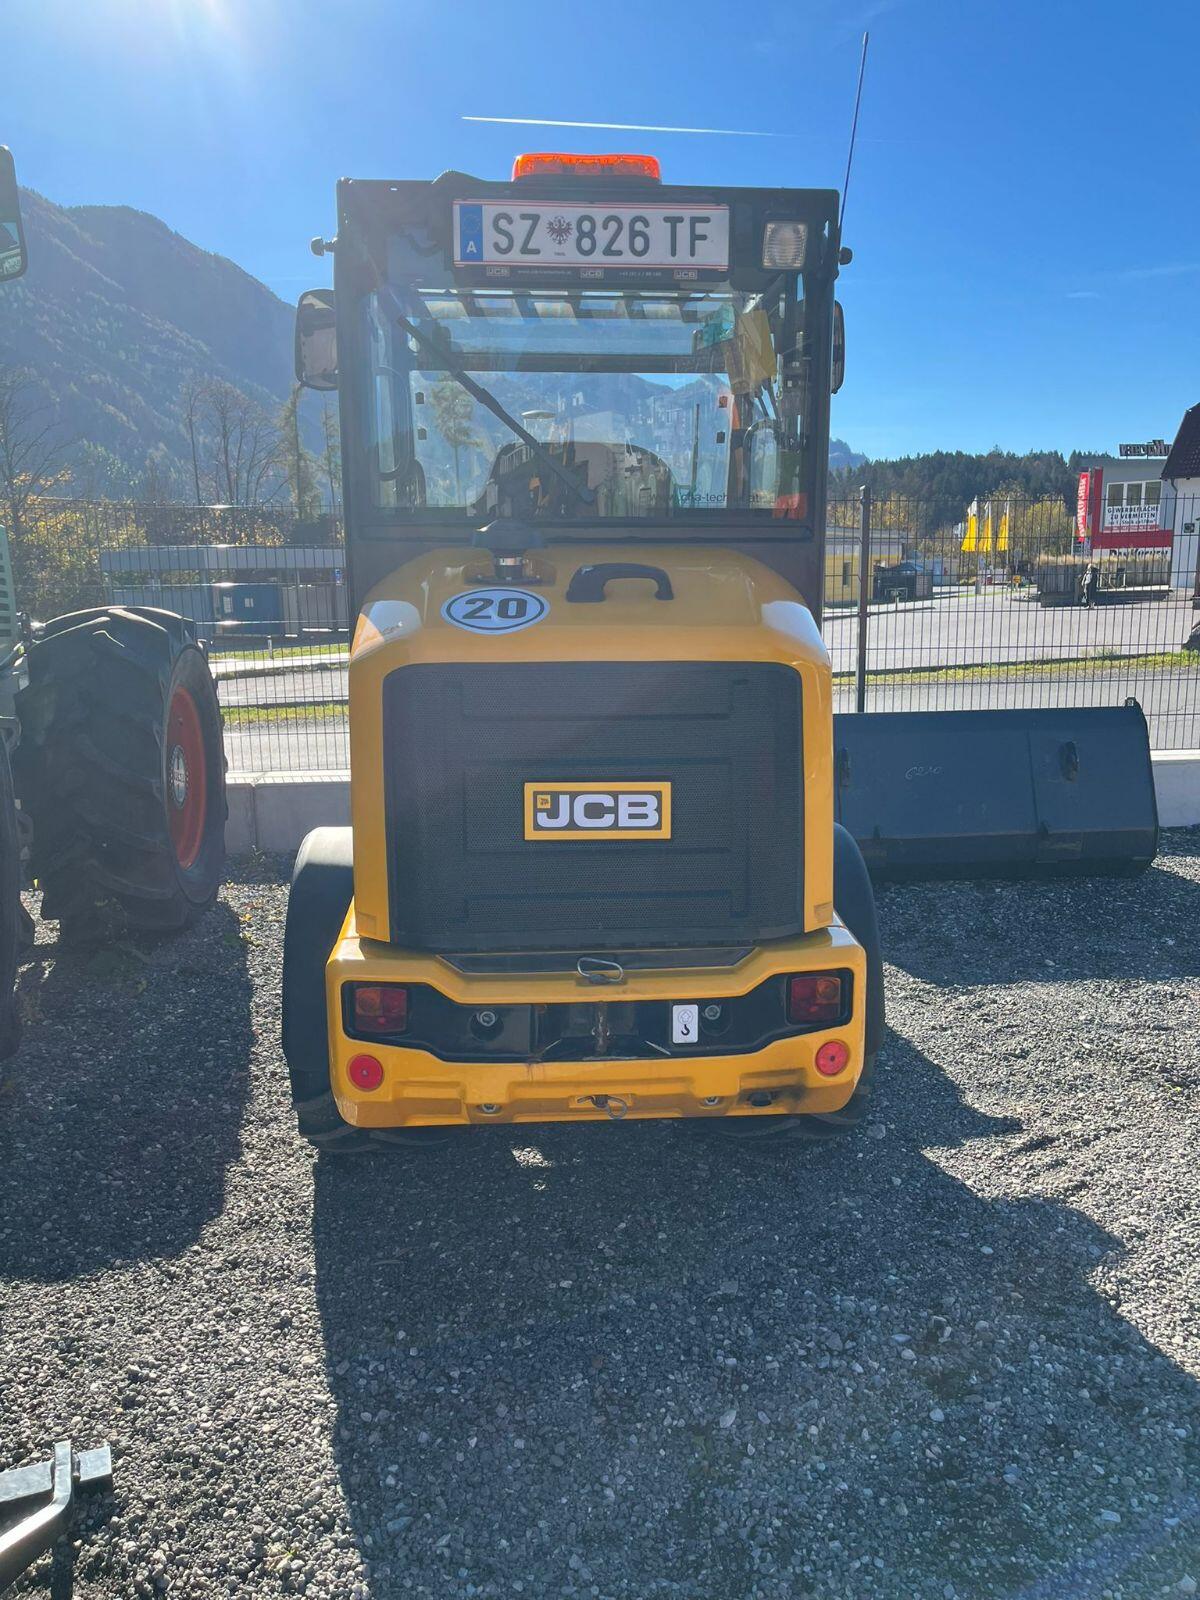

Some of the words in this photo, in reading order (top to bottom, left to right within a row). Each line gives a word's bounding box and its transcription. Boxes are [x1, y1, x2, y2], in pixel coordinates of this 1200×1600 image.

[492, 212, 541, 255] SZ
[575, 214, 650, 257] 826
[663, 216, 711, 258] TF
[466, 241, 477, 253] A
[1120, 512, 1155, 520] VERMIETEN
[462, 597, 528, 619] 20
[536, 794, 659, 828] JCB
